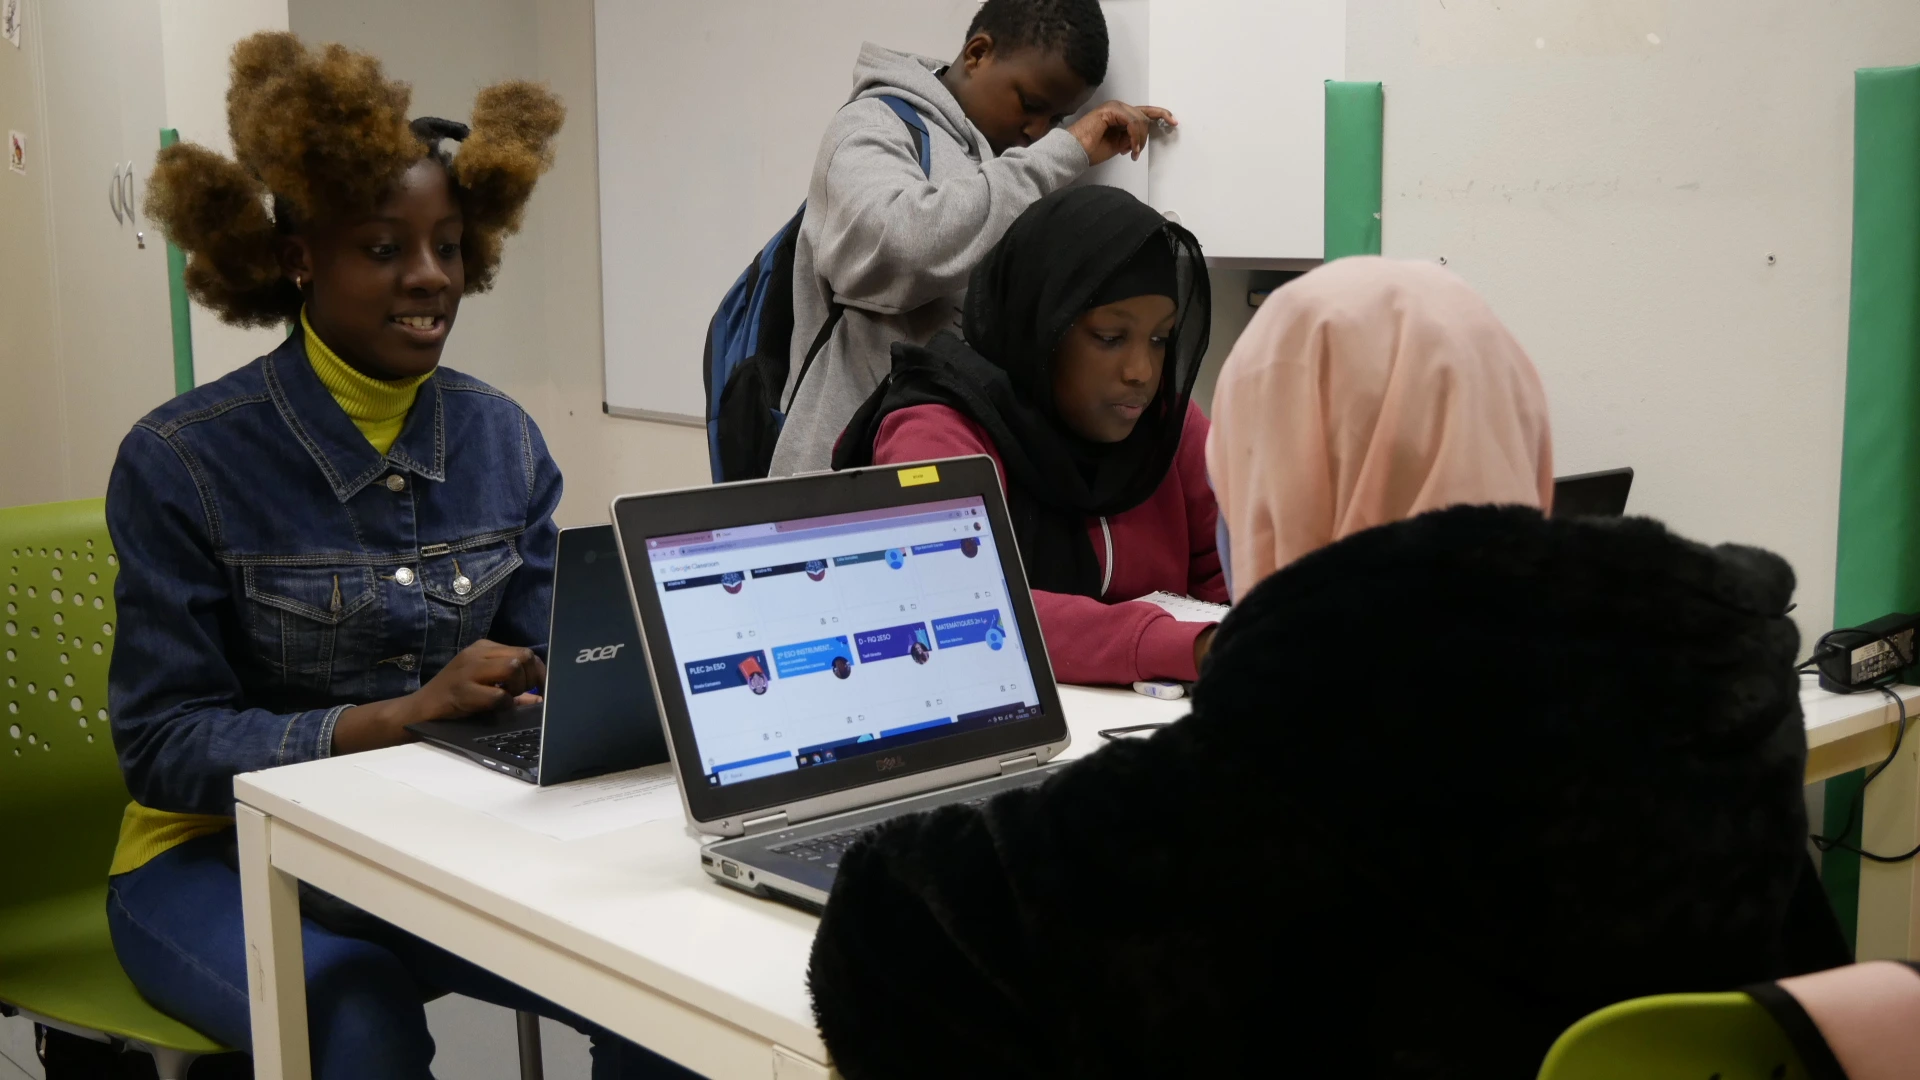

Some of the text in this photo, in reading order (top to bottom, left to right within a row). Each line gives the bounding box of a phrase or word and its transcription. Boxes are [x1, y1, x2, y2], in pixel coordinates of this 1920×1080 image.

[670, 560, 720, 574] Google Classroom
[876, 633, 891, 642] 2ESO
[575, 643, 625, 663] acer
[783, 650, 796, 658] ESO
[689, 666, 705, 675] PLEC
[713, 662, 726, 671] ESO
[876, 755, 906, 772] DELL
